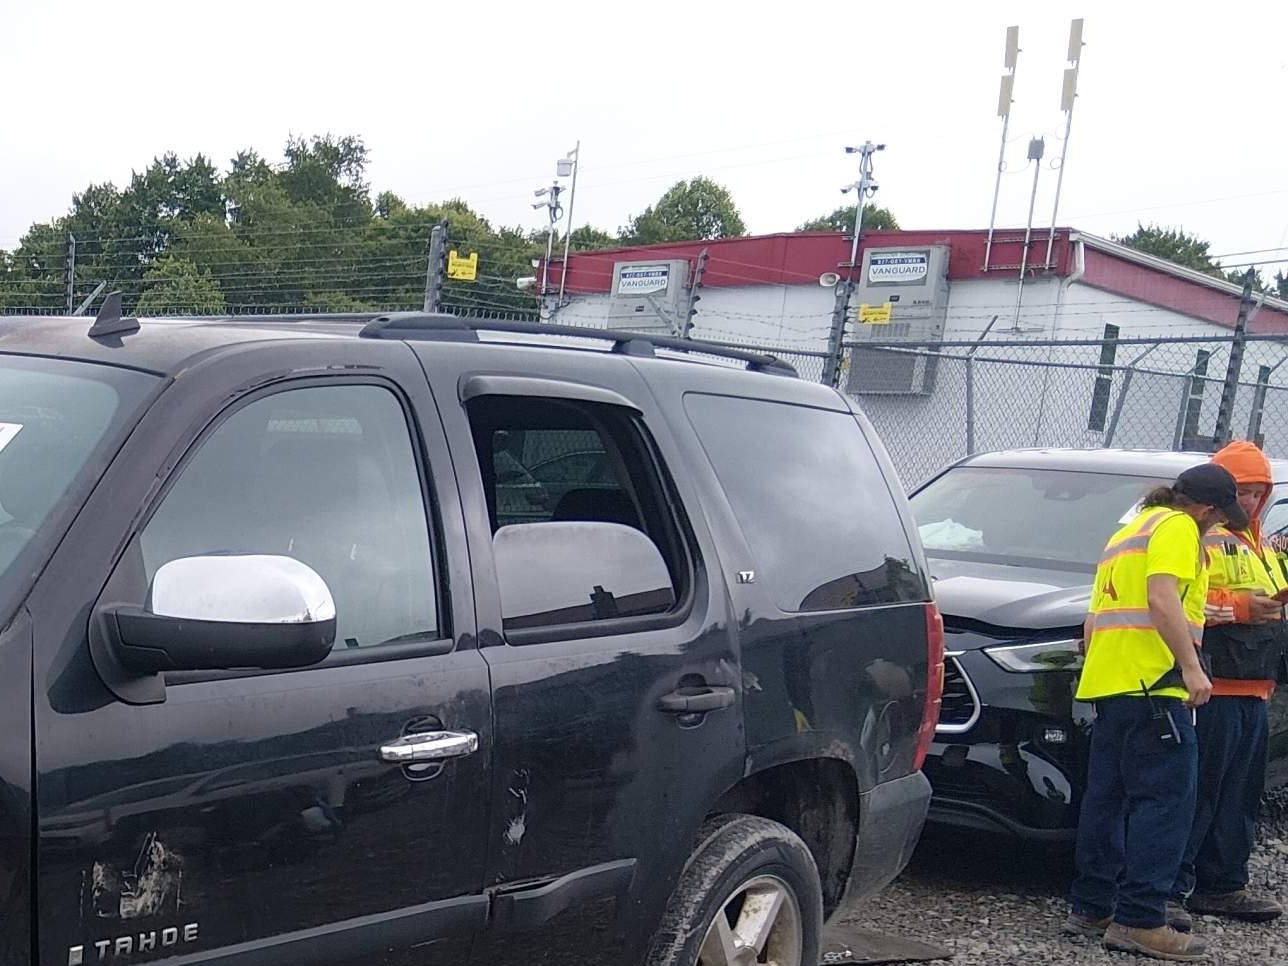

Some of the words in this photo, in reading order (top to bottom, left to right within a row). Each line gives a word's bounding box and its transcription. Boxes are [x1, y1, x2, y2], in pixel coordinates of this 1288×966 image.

[872, 266, 926, 275] VANGUARD
[621, 279, 666, 287] VANGUARD
[95, 922, 199, 961] TAHOE
